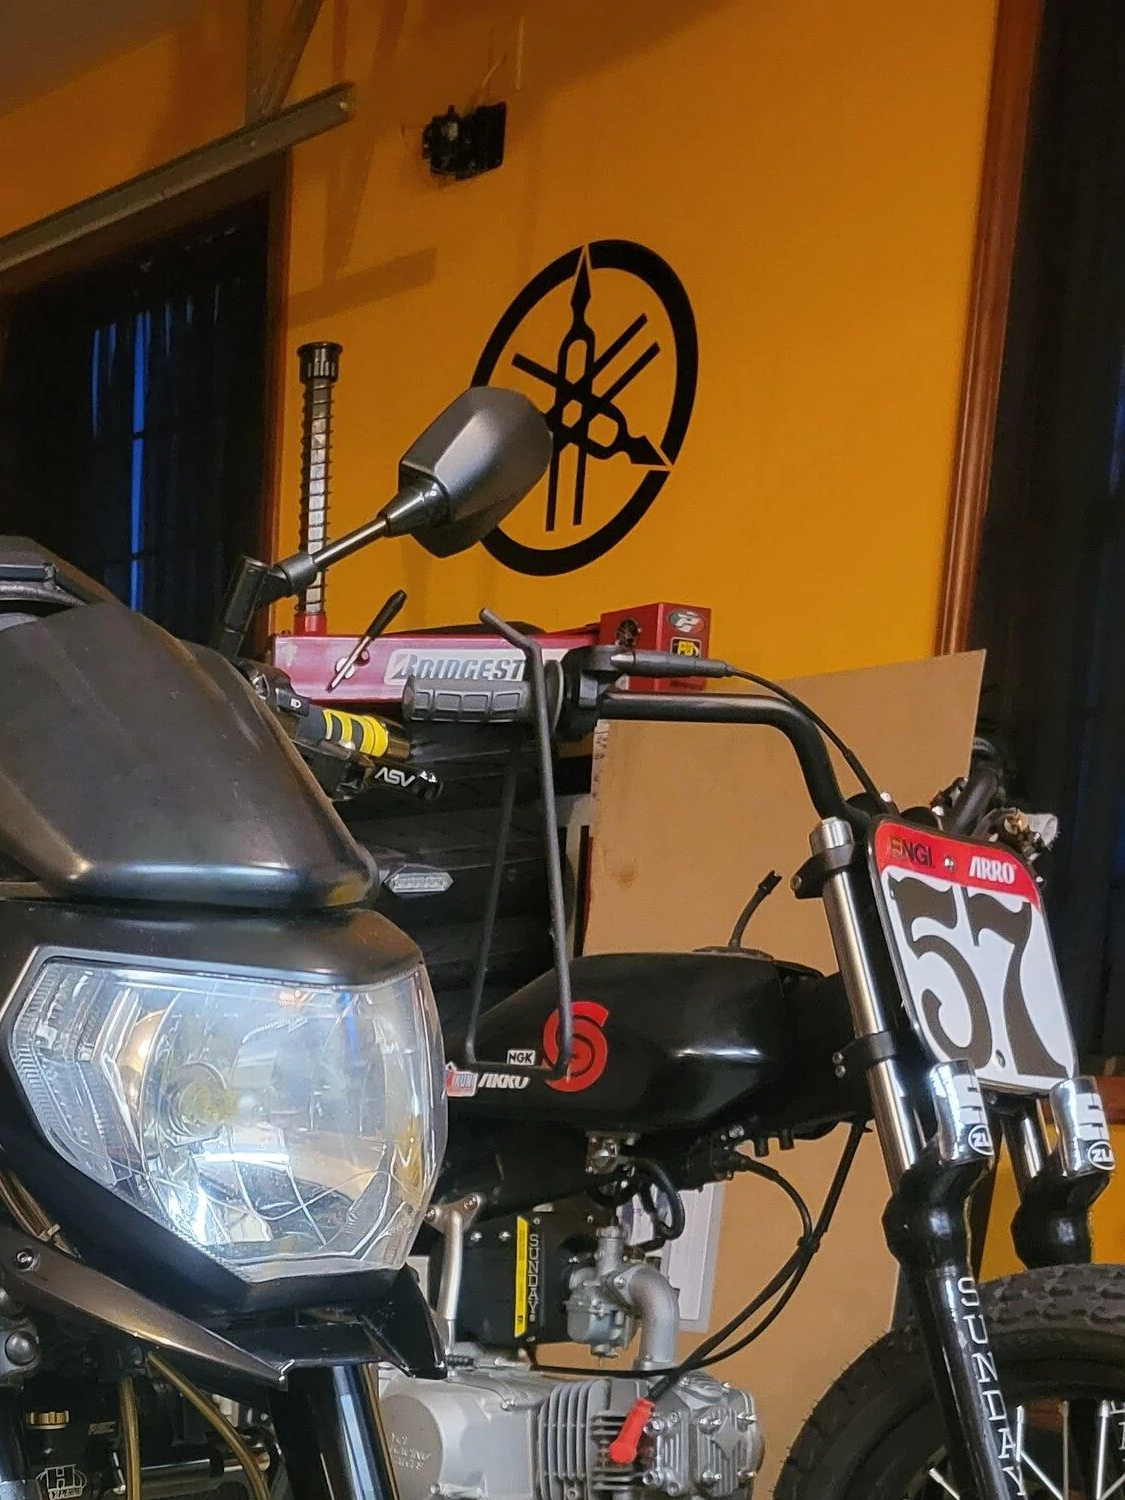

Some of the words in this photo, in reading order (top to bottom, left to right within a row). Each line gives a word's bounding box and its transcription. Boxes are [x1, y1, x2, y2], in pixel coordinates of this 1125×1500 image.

[375, 766, 416, 788] ASV
[887, 876, 1073, 1079] 57
[508, 1053, 534, 1065] NGK
[957, 1276, 1027, 1497] SUNDAY
